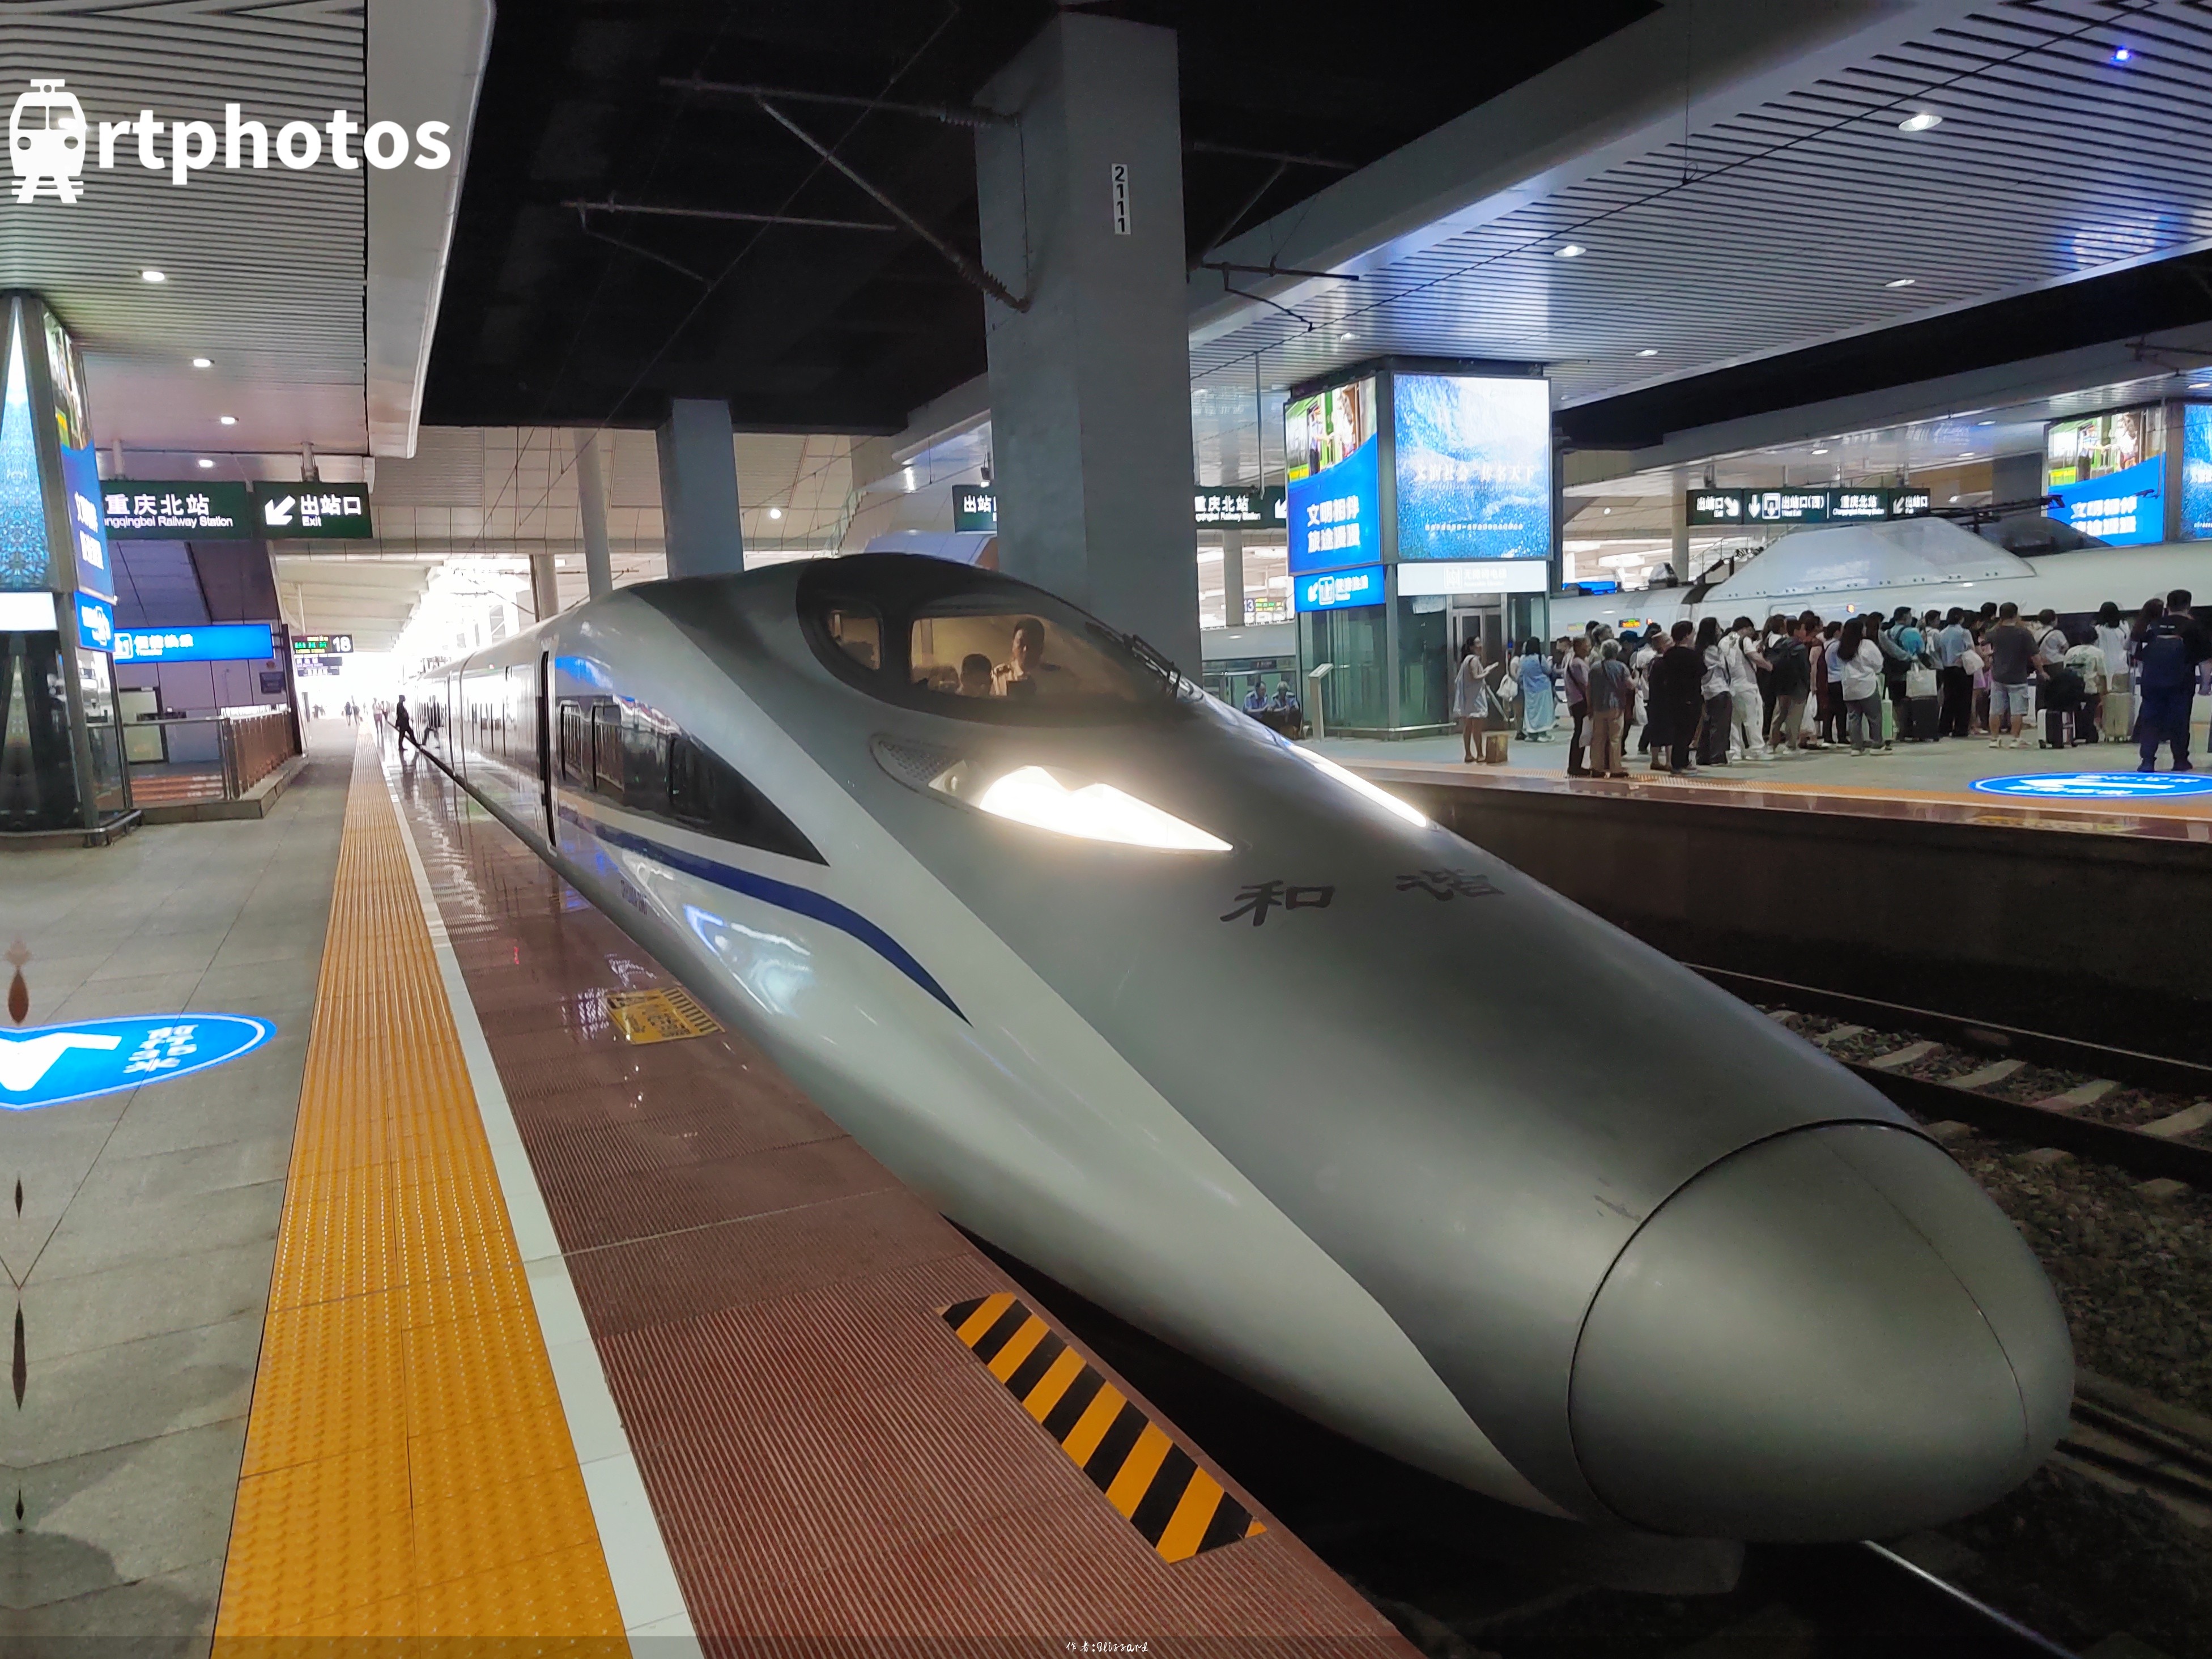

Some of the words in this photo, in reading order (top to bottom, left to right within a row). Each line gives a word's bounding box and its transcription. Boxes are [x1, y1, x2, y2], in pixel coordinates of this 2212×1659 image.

[1114, 165, 1125, 233] 2111
[105, 493, 210, 516] 重庆北站
[301, 494, 361, 516] 出站口
[964, 494, 997, 513] 出站
[1194, 494, 1249, 512] 重庆北站
[1697, 496, 1724, 511] 出站口
[1840, 494, 1878, 508] 重庆北站
[1307, 495, 1360, 528] 文明相伴
[158, 516, 198, 529] Railway
[199, 515, 233, 527] Station
[302, 516, 322, 526] Exit
[1244, 599, 1254, 612] 13
[333, 636, 351, 652] 18
